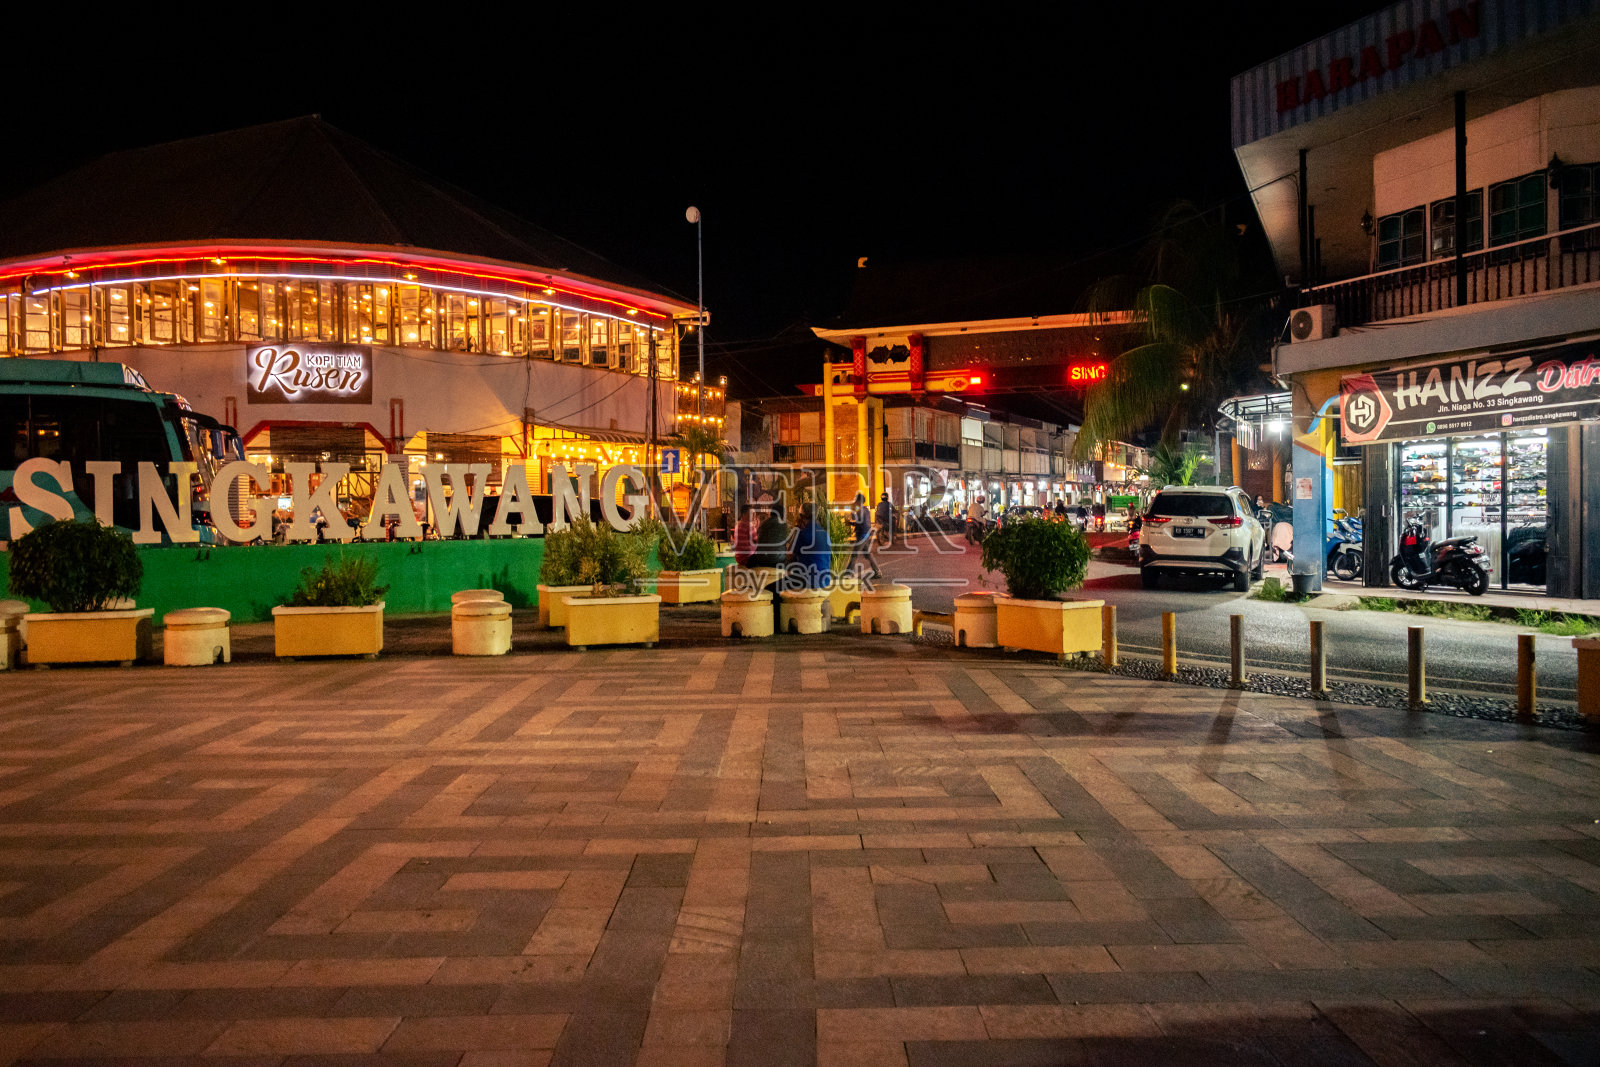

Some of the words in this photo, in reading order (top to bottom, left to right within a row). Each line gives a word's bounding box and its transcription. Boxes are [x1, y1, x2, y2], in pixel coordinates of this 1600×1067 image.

[1276, 1, 1481, 114] HARAPAN
[255, 348, 362, 394] Rusen
[306, 355, 334, 367] KOPI
[338, 355, 361, 368] TIAM
[1393, 356, 1533, 411] HANZZ
[1437, 404, 1450, 413] Jln.
[1451, 402, 1471, 412] Niaga
[1472, 401, 1485, 409] No.
[1486, 399, 1495, 407] 33
[1497, 394, 1543, 406] Singkawang
[8, 457, 650, 543] SINGKAWANG
